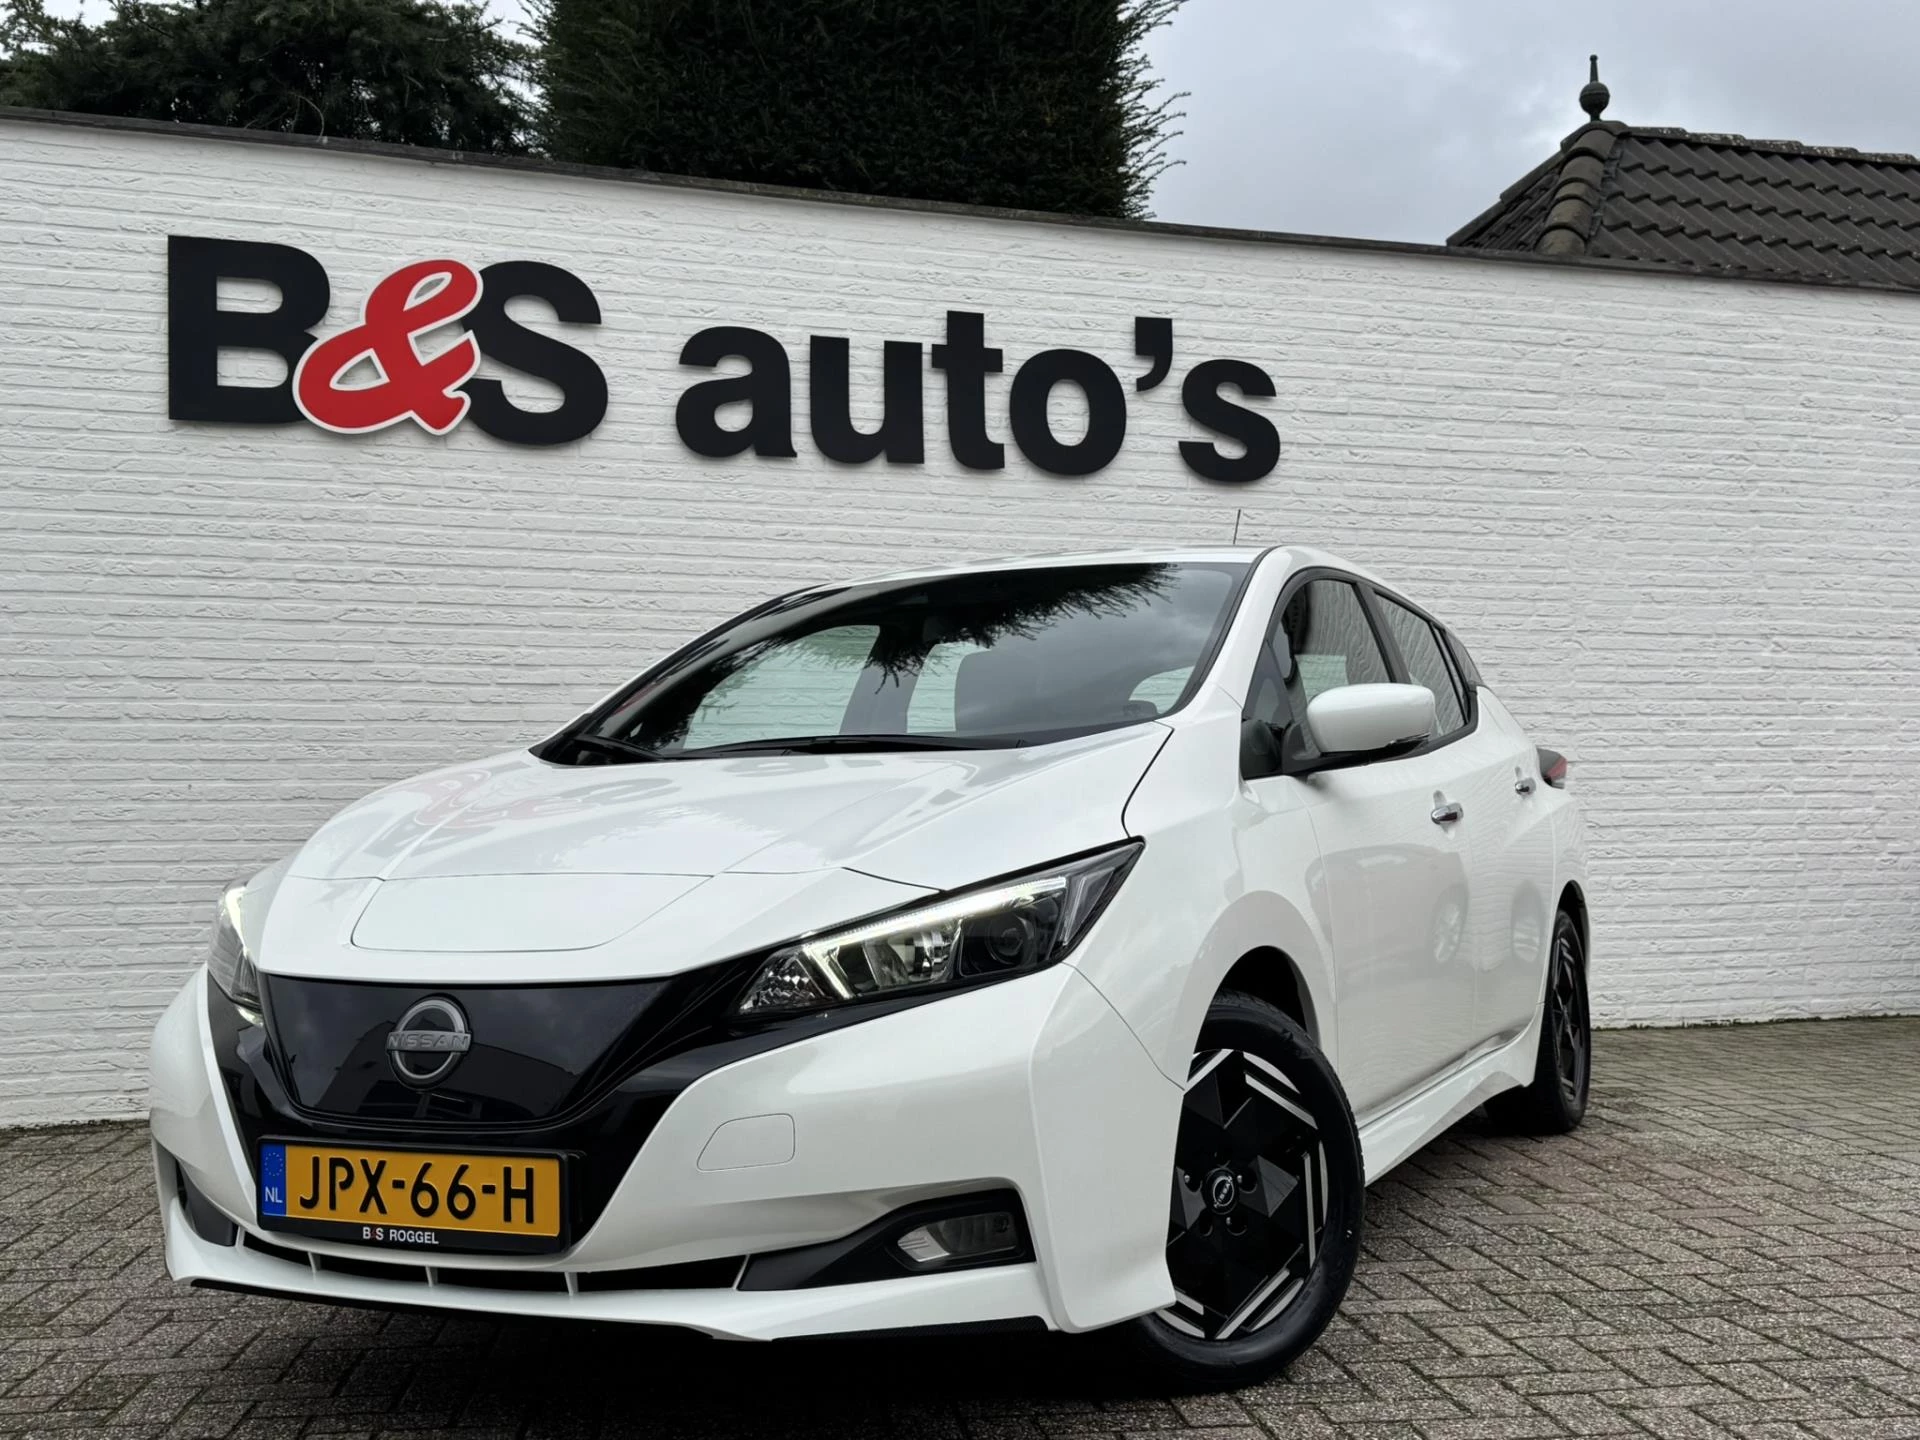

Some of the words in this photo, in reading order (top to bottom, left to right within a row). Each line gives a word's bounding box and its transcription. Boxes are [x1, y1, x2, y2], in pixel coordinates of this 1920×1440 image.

[168, 235, 608, 446] B&S
[675, 310, 1281, 483] auto's
[388, 1033, 469, 1050] NISSAN
[265, 1186, 283, 1203] NL
[299, 1156, 534, 1224] JPX-66-H
[389, 1229, 439, 1245] ROGGEL
